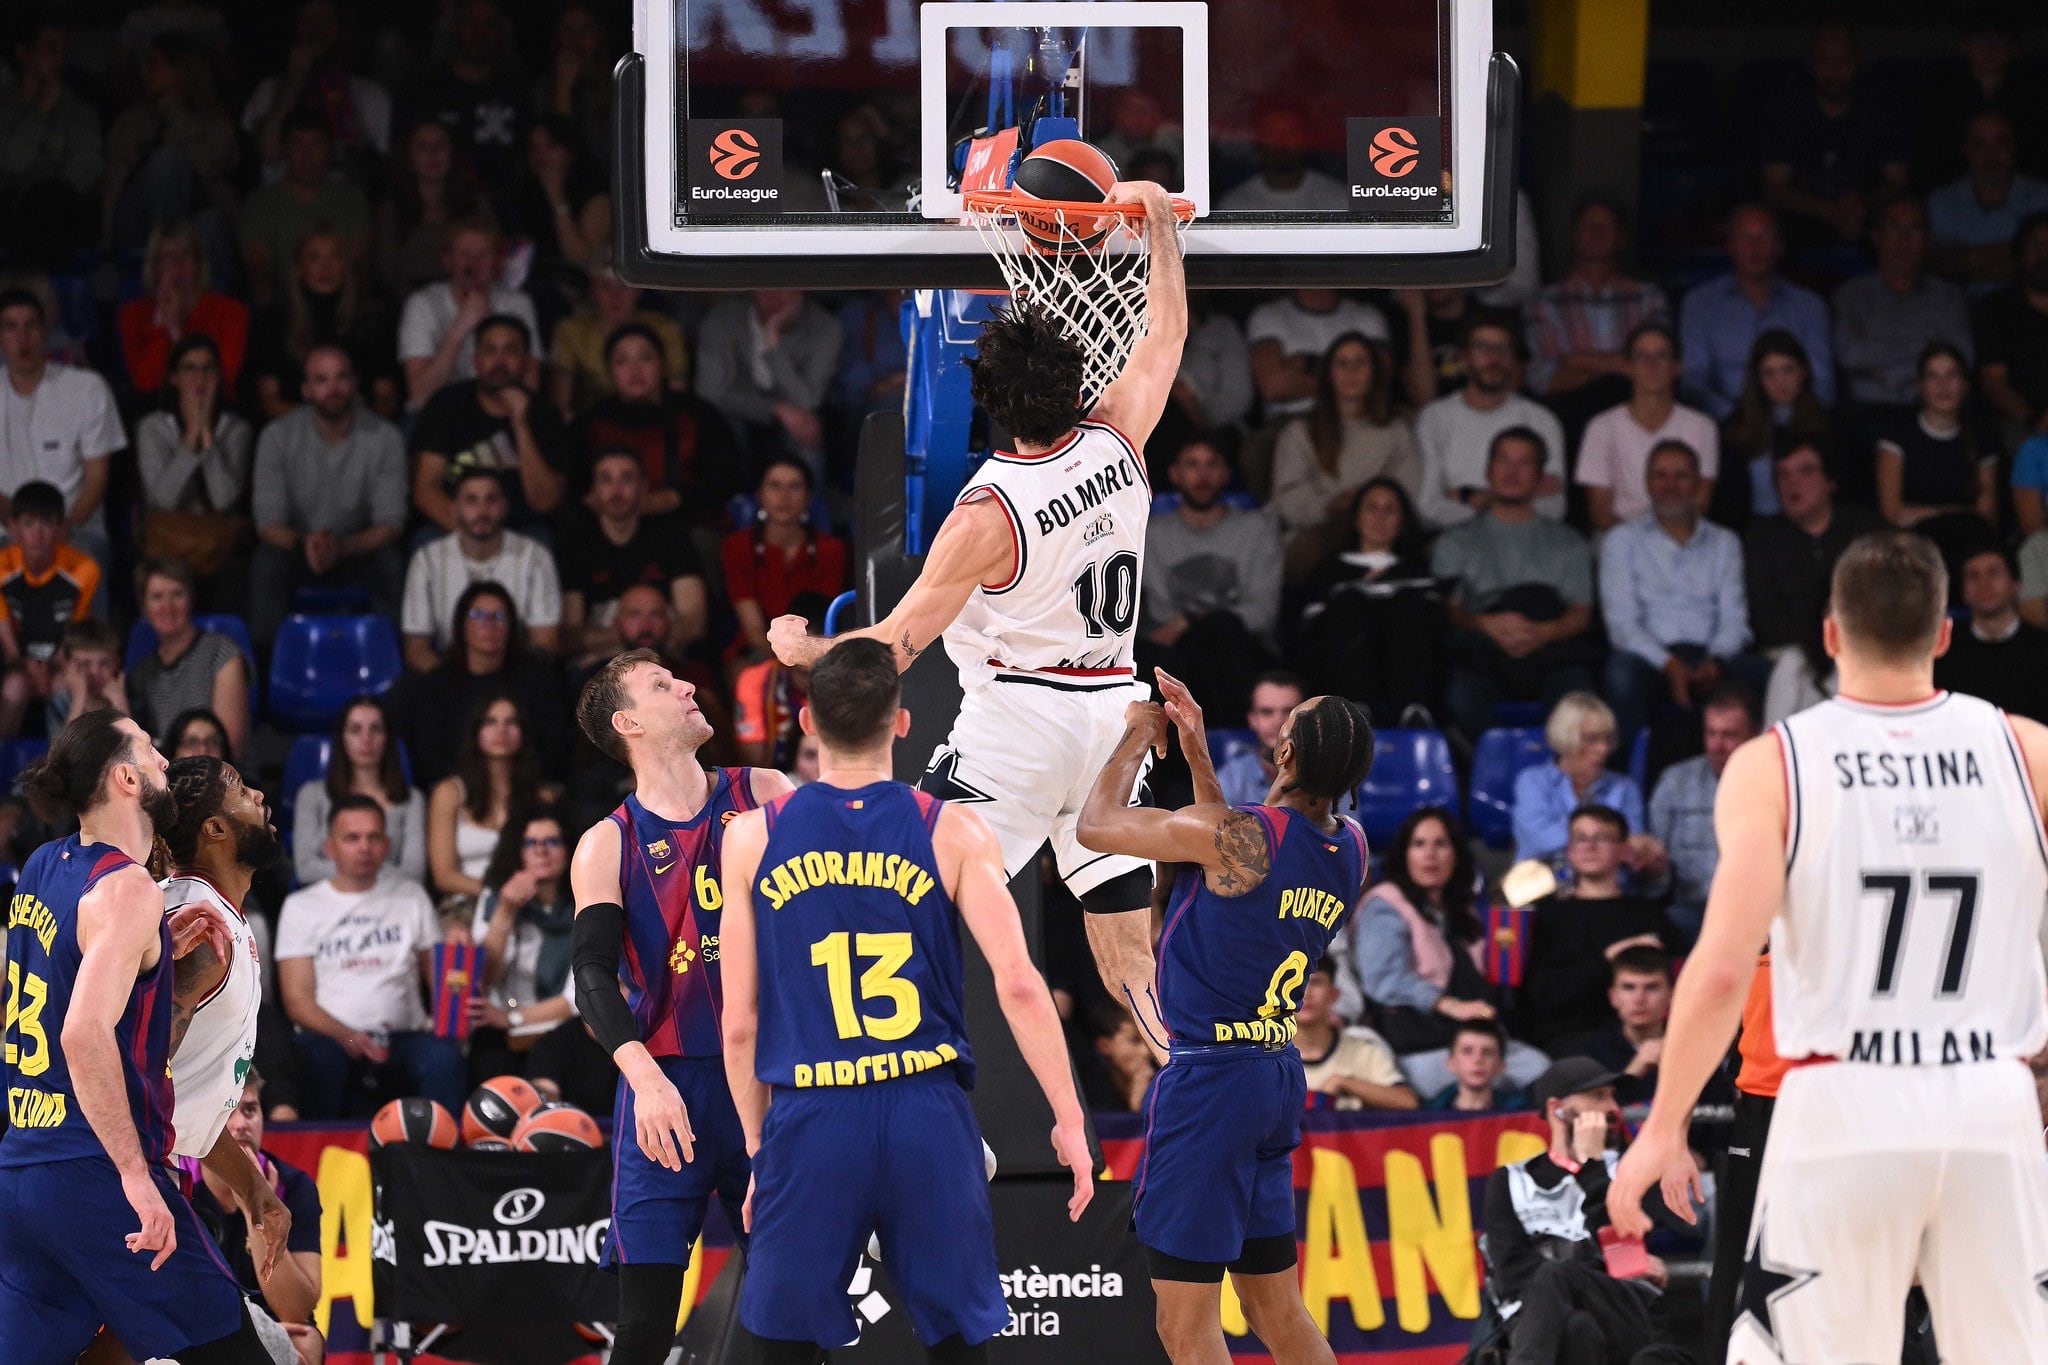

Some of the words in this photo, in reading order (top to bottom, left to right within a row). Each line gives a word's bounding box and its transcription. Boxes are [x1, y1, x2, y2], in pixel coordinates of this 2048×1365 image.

[691, 186, 779, 202] EuroLeague
[1351, 184, 1438, 201] EuroLeague
[1034, 458, 1134, 537] BOLMARO
[1071, 550, 1138, 638] 10
[1834, 751, 1984, 789] SESTINA
[694, 865, 722, 911] 6
[759, 851, 936, 911] SATORANSKY
[1278, 887, 1345, 930] PUNTER
[1861, 869, 1984, 1000] 77
[810, 931, 922, 1041] 13
[6, 959, 50, 1077] 23
[423, 1219, 611, 1267] SPALDING
